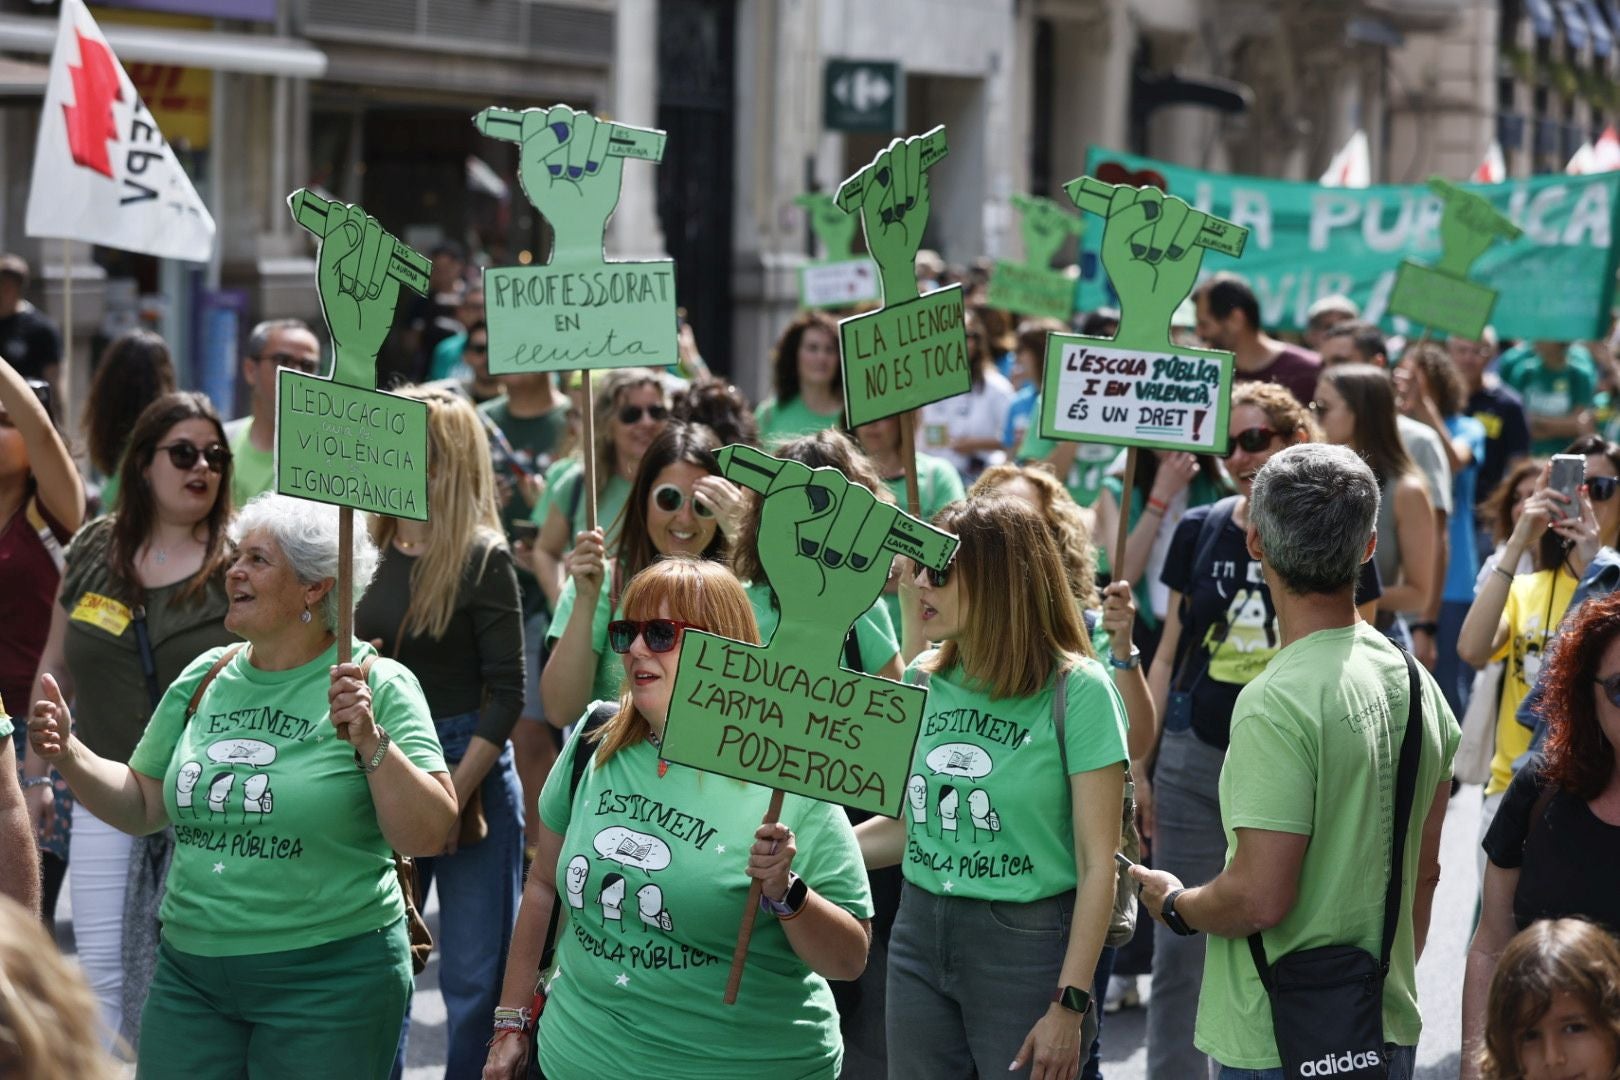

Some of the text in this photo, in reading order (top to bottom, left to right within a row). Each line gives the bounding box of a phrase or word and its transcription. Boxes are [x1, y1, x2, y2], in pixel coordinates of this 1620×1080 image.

[494, 271, 671, 309] PROFESSORAT
[554, 313, 580, 332] EN
[855, 302, 964, 359] LA LLENGUA
[865, 341, 968, 400] NO ES TOCA
[1066, 349, 1147, 376] L'ESCOLA
[1082, 379, 1101, 396] I
[1104, 380, 1131, 397] EN
[1067, 398, 1089, 420] ÉS
[1102, 406, 1129, 423] UN
[297, 429, 414, 471] VIOLÈNCIA
[291, 466, 416, 513] IGNORÀNCIA
[695, 640, 907, 723] L'EDUCACIÓ ÉS
[687, 679, 864, 750] L'ARMA MÉS
[924, 708, 1029, 751] ESTIMEM
[716, 725, 885, 806] PODEROSA
[595, 789, 719, 851] ESTIMEM
[1300, 1050, 1380, 1077] adidas
